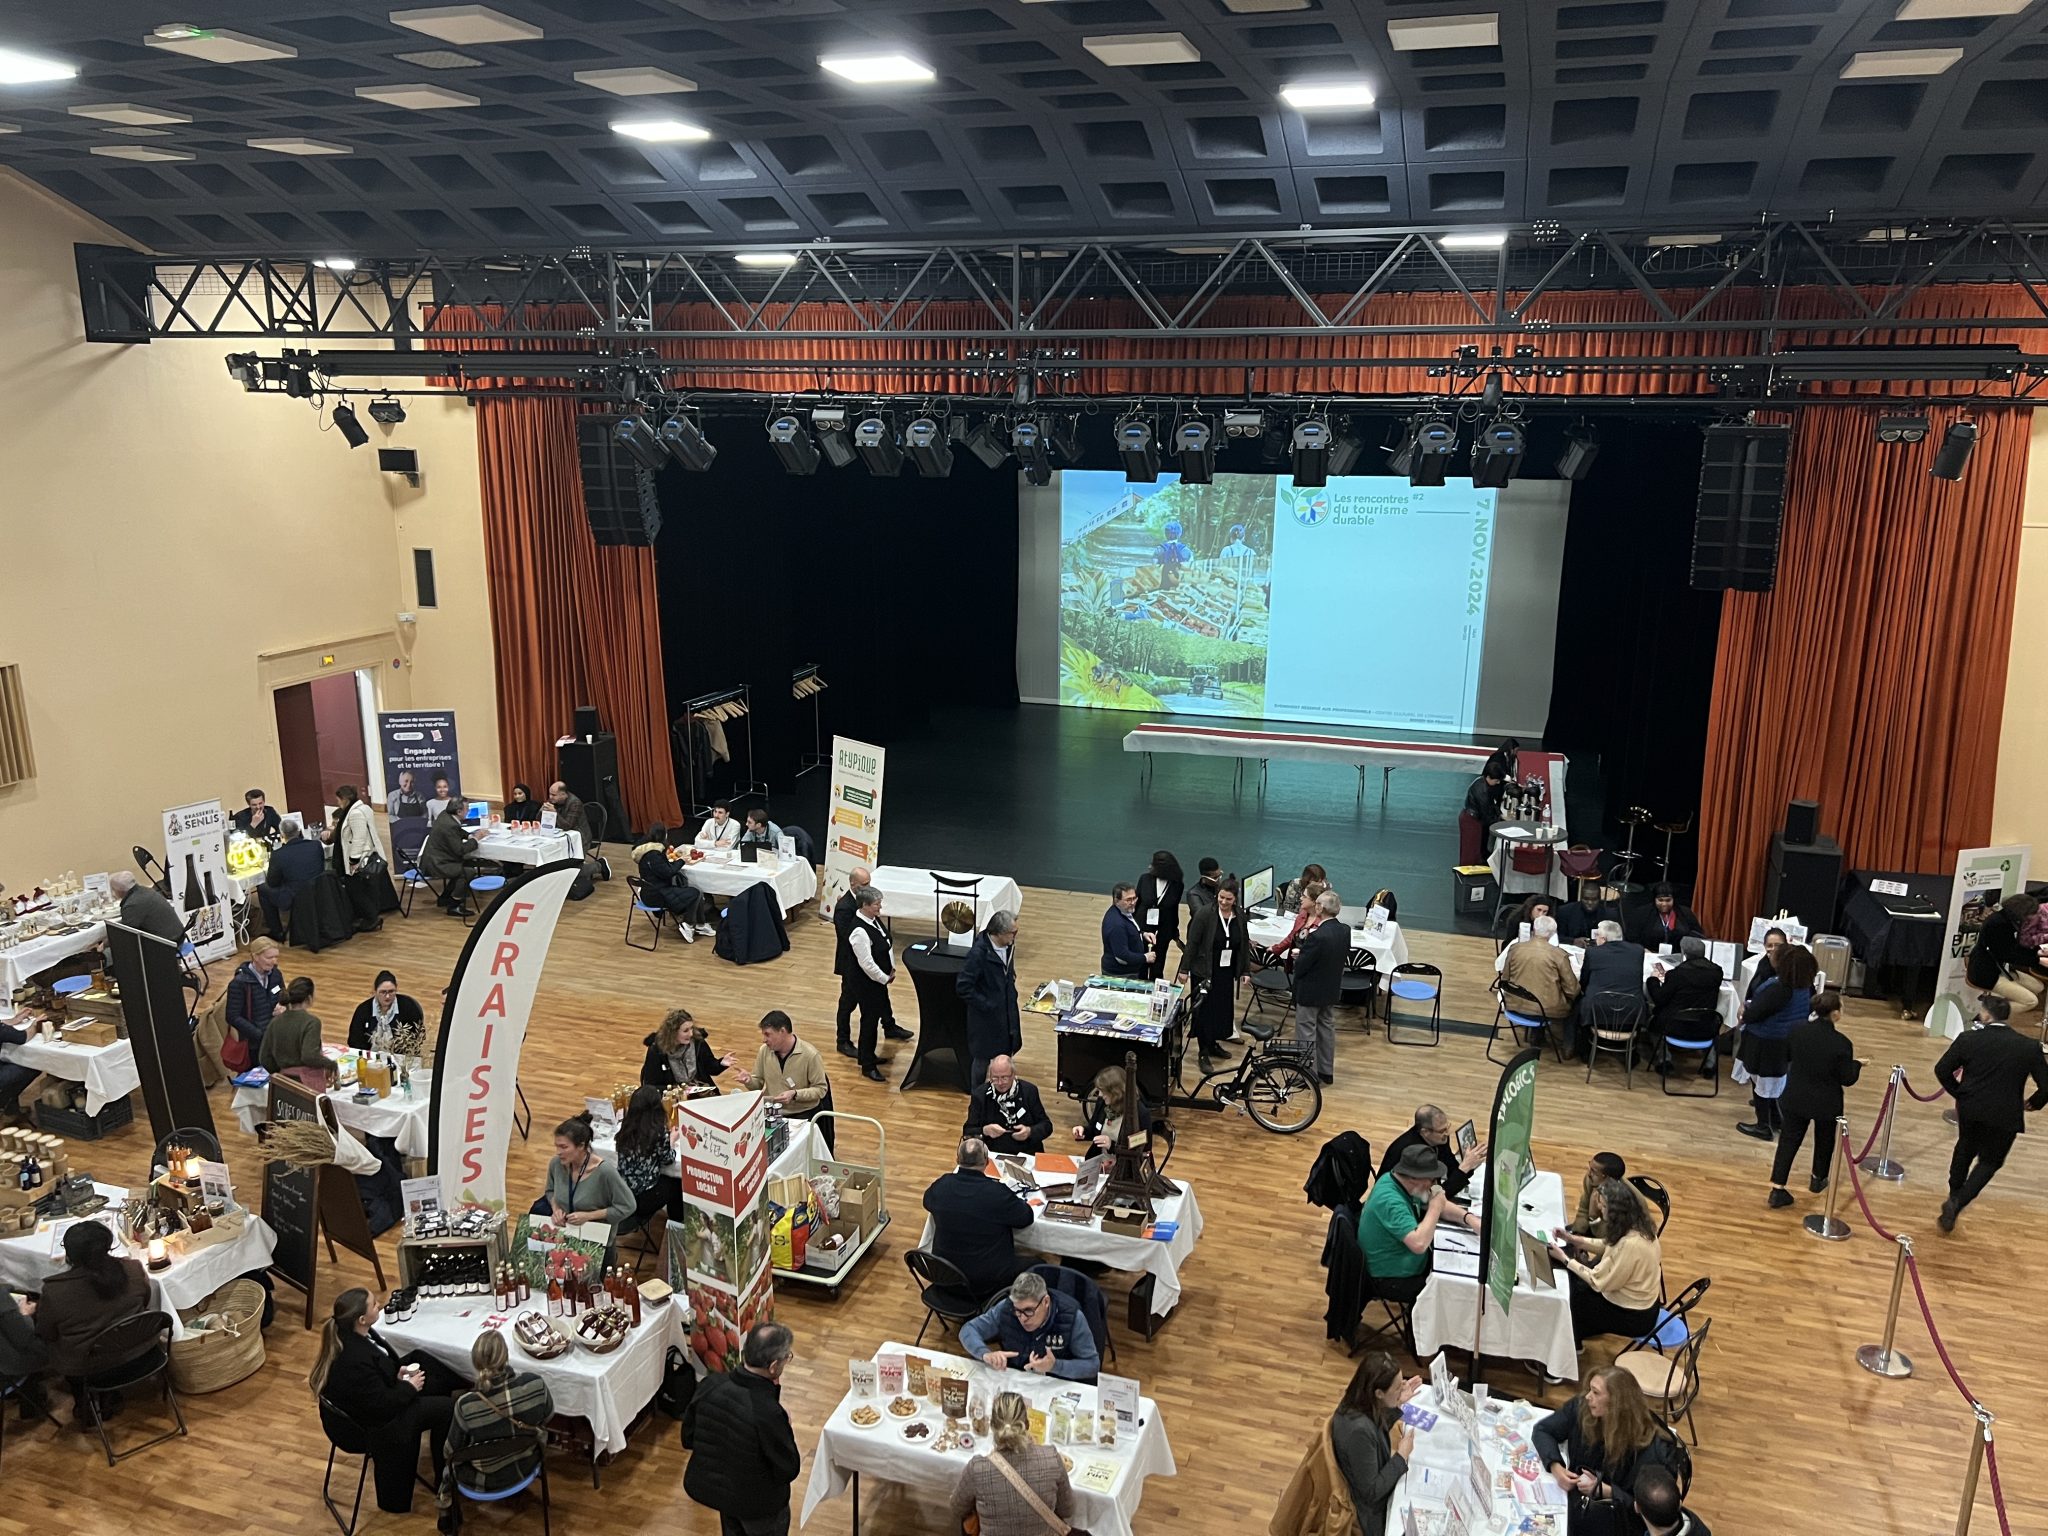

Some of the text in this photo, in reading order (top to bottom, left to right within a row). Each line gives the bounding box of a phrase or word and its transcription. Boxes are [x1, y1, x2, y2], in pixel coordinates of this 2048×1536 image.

[1334, 493, 1409, 504] Les rencontres
[1412, 493, 1424, 501] #2
[1333, 503, 1409, 515] du tourisme
[1332, 514, 1375, 526] durable
[404, 748, 436, 756] Engagée
[184, 809, 214, 820] BRASSERIE
[184, 814, 220, 830] SENLIS
[462, 902, 536, 1184] FRAISES
[686, 1164, 724, 1186] PRODUCTION
[696, 1180, 718, 1196] LOCALE
